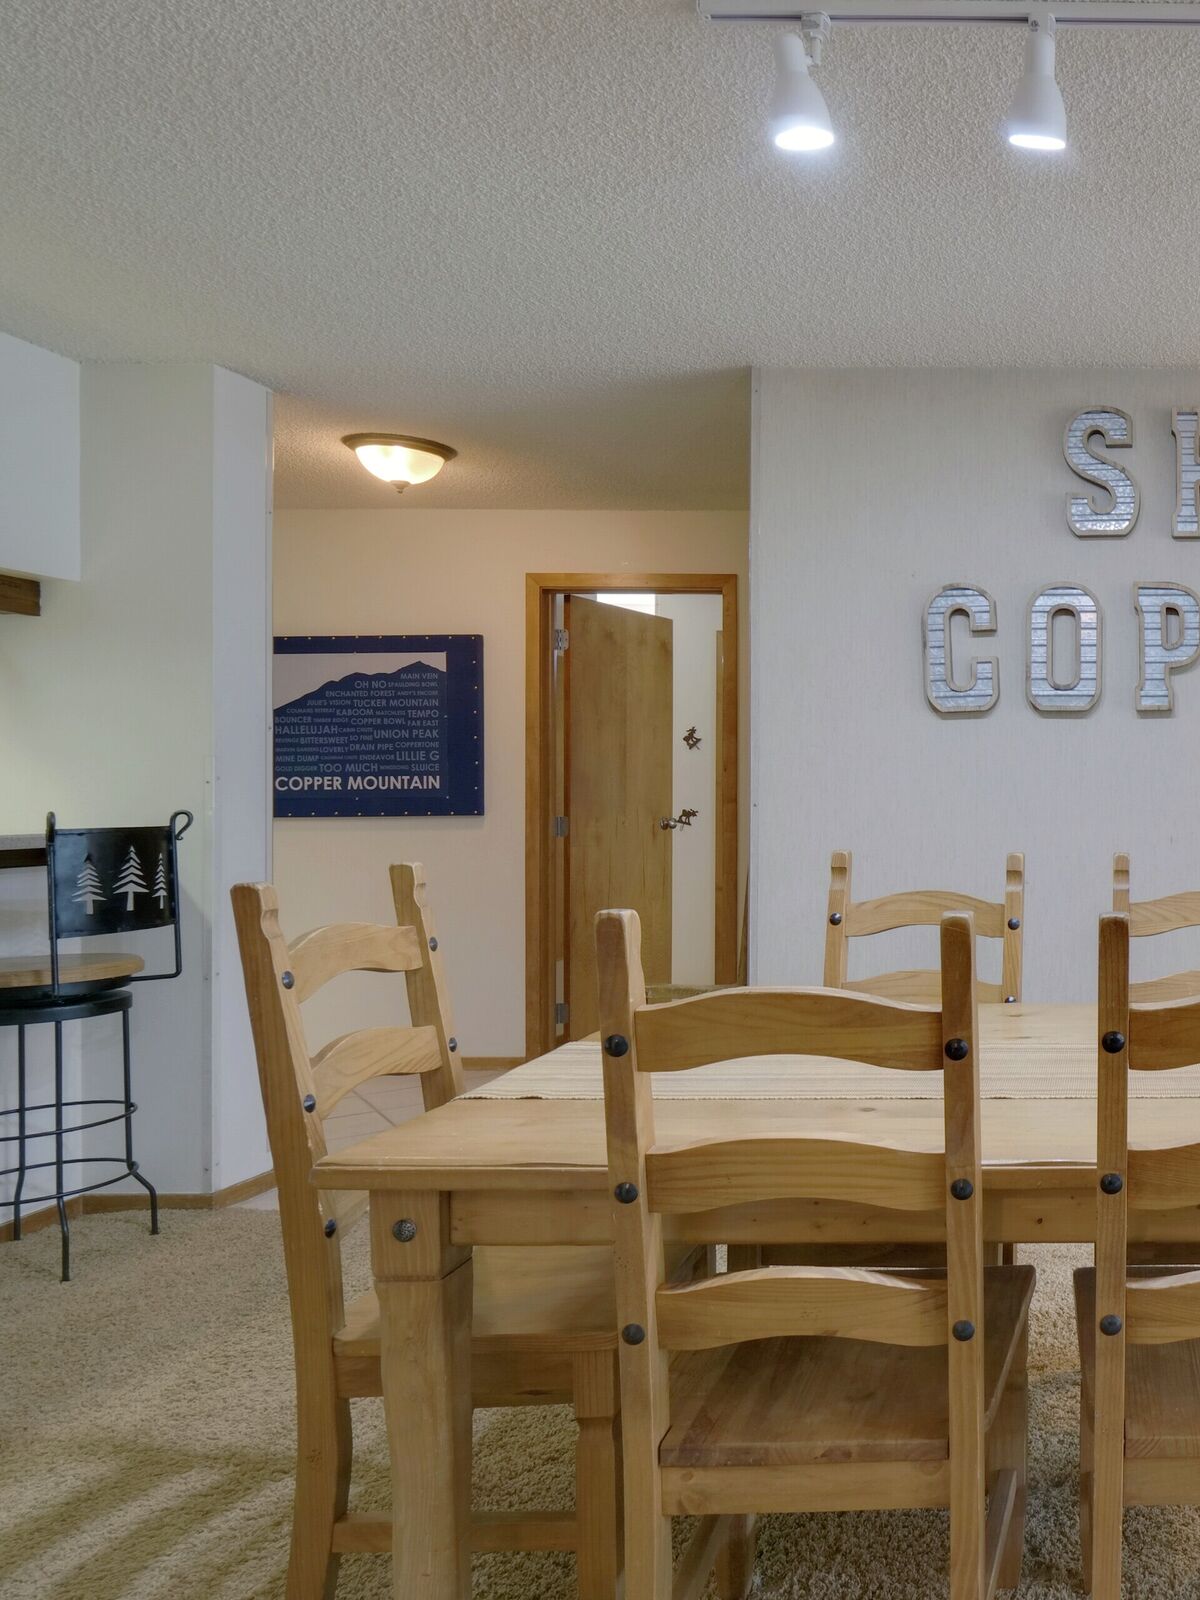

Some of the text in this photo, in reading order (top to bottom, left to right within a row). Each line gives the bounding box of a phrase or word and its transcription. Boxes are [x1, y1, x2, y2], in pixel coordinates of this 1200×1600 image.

[354, 680, 369, 689] OH
[371, 680, 387, 689] NO
[352, 699, 387, 707] TUCKER
[389, 698, 439, 707] MOUNTAIN
[336, 708, 373, 716] KABOOM
[407, 709, 439, 718] TEMPO
[350, 717, 382, 725] COPPER
[275, 725, 338, 734] HALLELUJAH
[373, 729, 409, 739] UNION
[412, 729, 439, 739] PEAK
[299, 736, 348, 744] BITTERSWEET
[349, 743, 375, 751] DRAIN
[377, 743, 394, 751] PIPE
[396, 751, 426, 761] LILLIE
[429, 750, 440, 761] G
[318, 763, 342, 773] TOO
[345, 763, 378, 773] MUCH
[410, 763, 440, 772] SLUICE
[275, 775, 440, 791] COPPER MOUNTAIN
